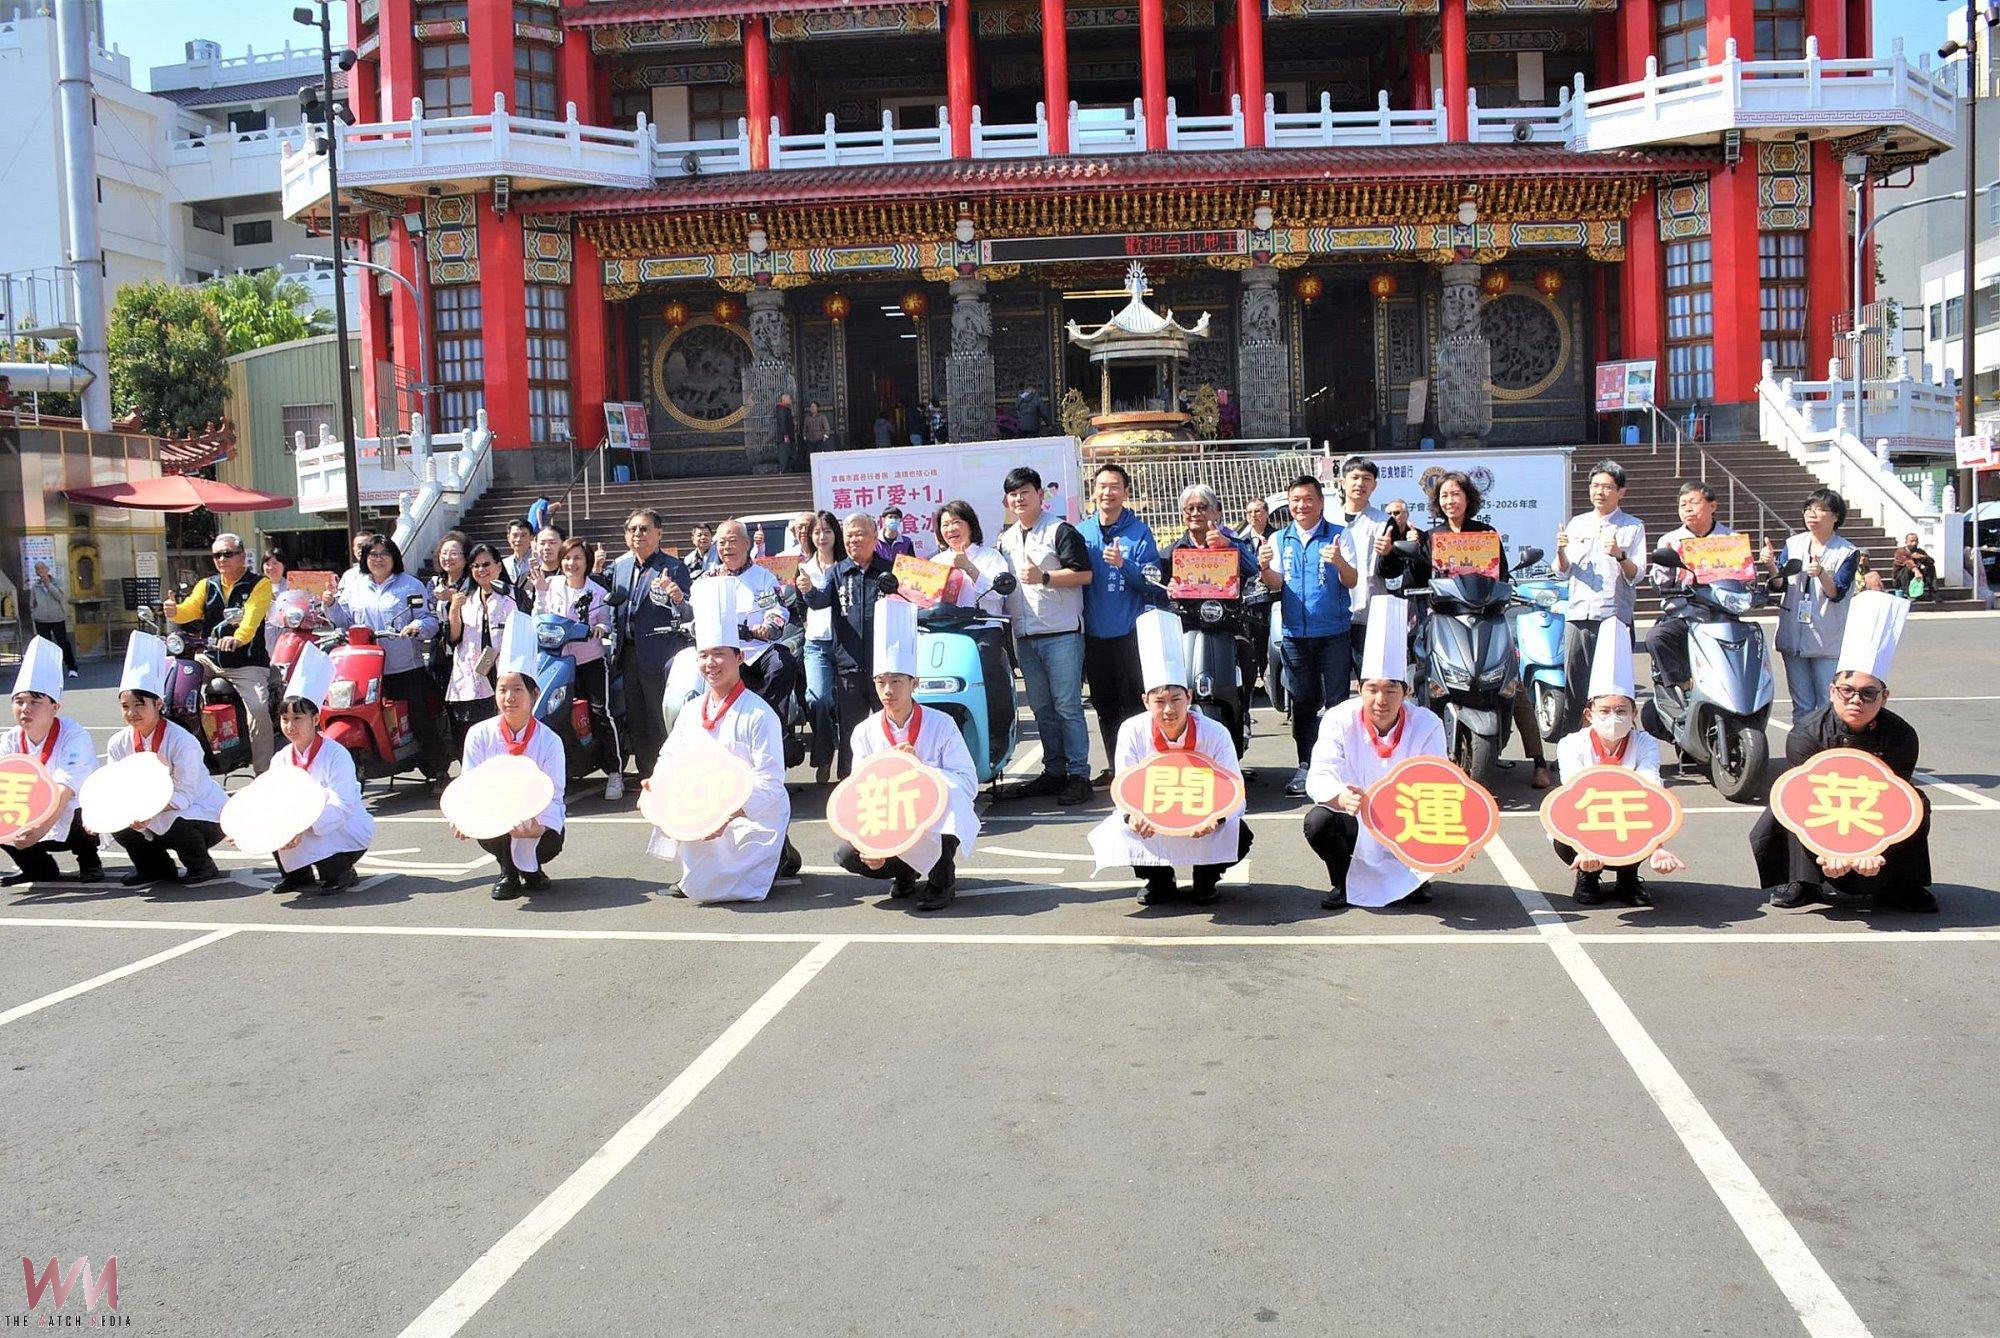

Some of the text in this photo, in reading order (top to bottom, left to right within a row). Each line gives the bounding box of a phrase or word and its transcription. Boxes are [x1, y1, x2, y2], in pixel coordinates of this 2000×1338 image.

[832, 485, 943, 509] 嘉市「愛+1」
[855, 769, 922, 837] 新
[1143, 765, 1215, 815] 開
[1395, 781, 1470, 847] 運
[1574, 787, 1653, 842] 年
[1803, 771, 1889, 836] 菜
